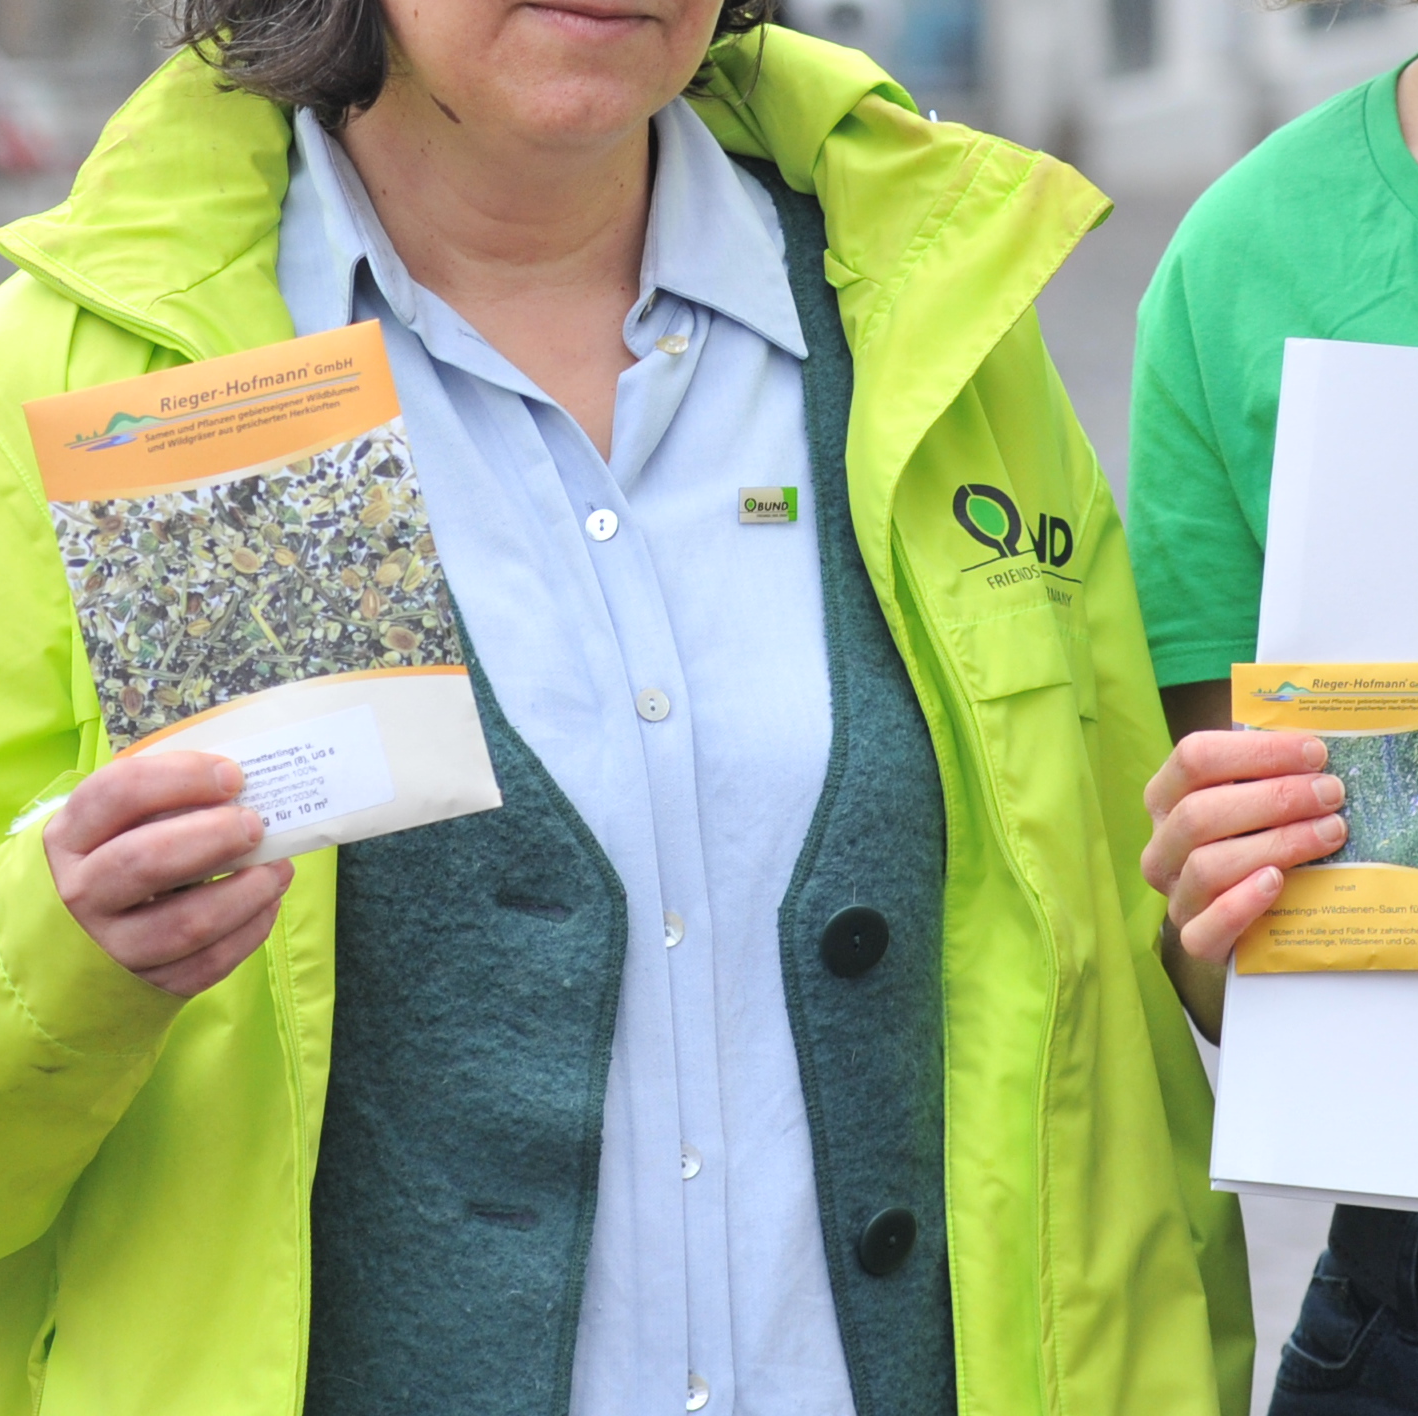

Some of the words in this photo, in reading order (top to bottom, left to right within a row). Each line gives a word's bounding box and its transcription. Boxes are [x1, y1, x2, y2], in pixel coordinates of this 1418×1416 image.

[313, 357, 354, 376] GmbH
[144, 428, 175, 443] Samen
[177, 422, 195, 435] und
[197, 414, 236, 430] Pflanzen
[238, 397, 304, 421] gebietseigener
[307, 384, 360, 403] Wildblumen
[147, 441, 166, 453] und
[168, 429, 216, 448] Wildgräser
[218, 425, 234, 437] aus
[236, 412, 288, 433] gesicherten
[290, 399, 341, 419] Herkünften
[757, 501, 789, 512] BUND
[986, 564, 1041, 590] FRIENDS
[292, 765, 318, 778] 100%
[262, 816, 271, 827] g
[275, 809, 292, 822] für
[298, 803, 312, 815] 10
[1334, 884, 1356, 892] Inhalt
[1269, 928, 1295, 937] Blüten
[1306, 927, 1327, 935] Hülle
[1328, 927, 1344, 935] und
[1346, 927, 1365, 935] Fülle
[1367, 927, 1378, 935] für
[1403, 937, 1418, 945] Co.
